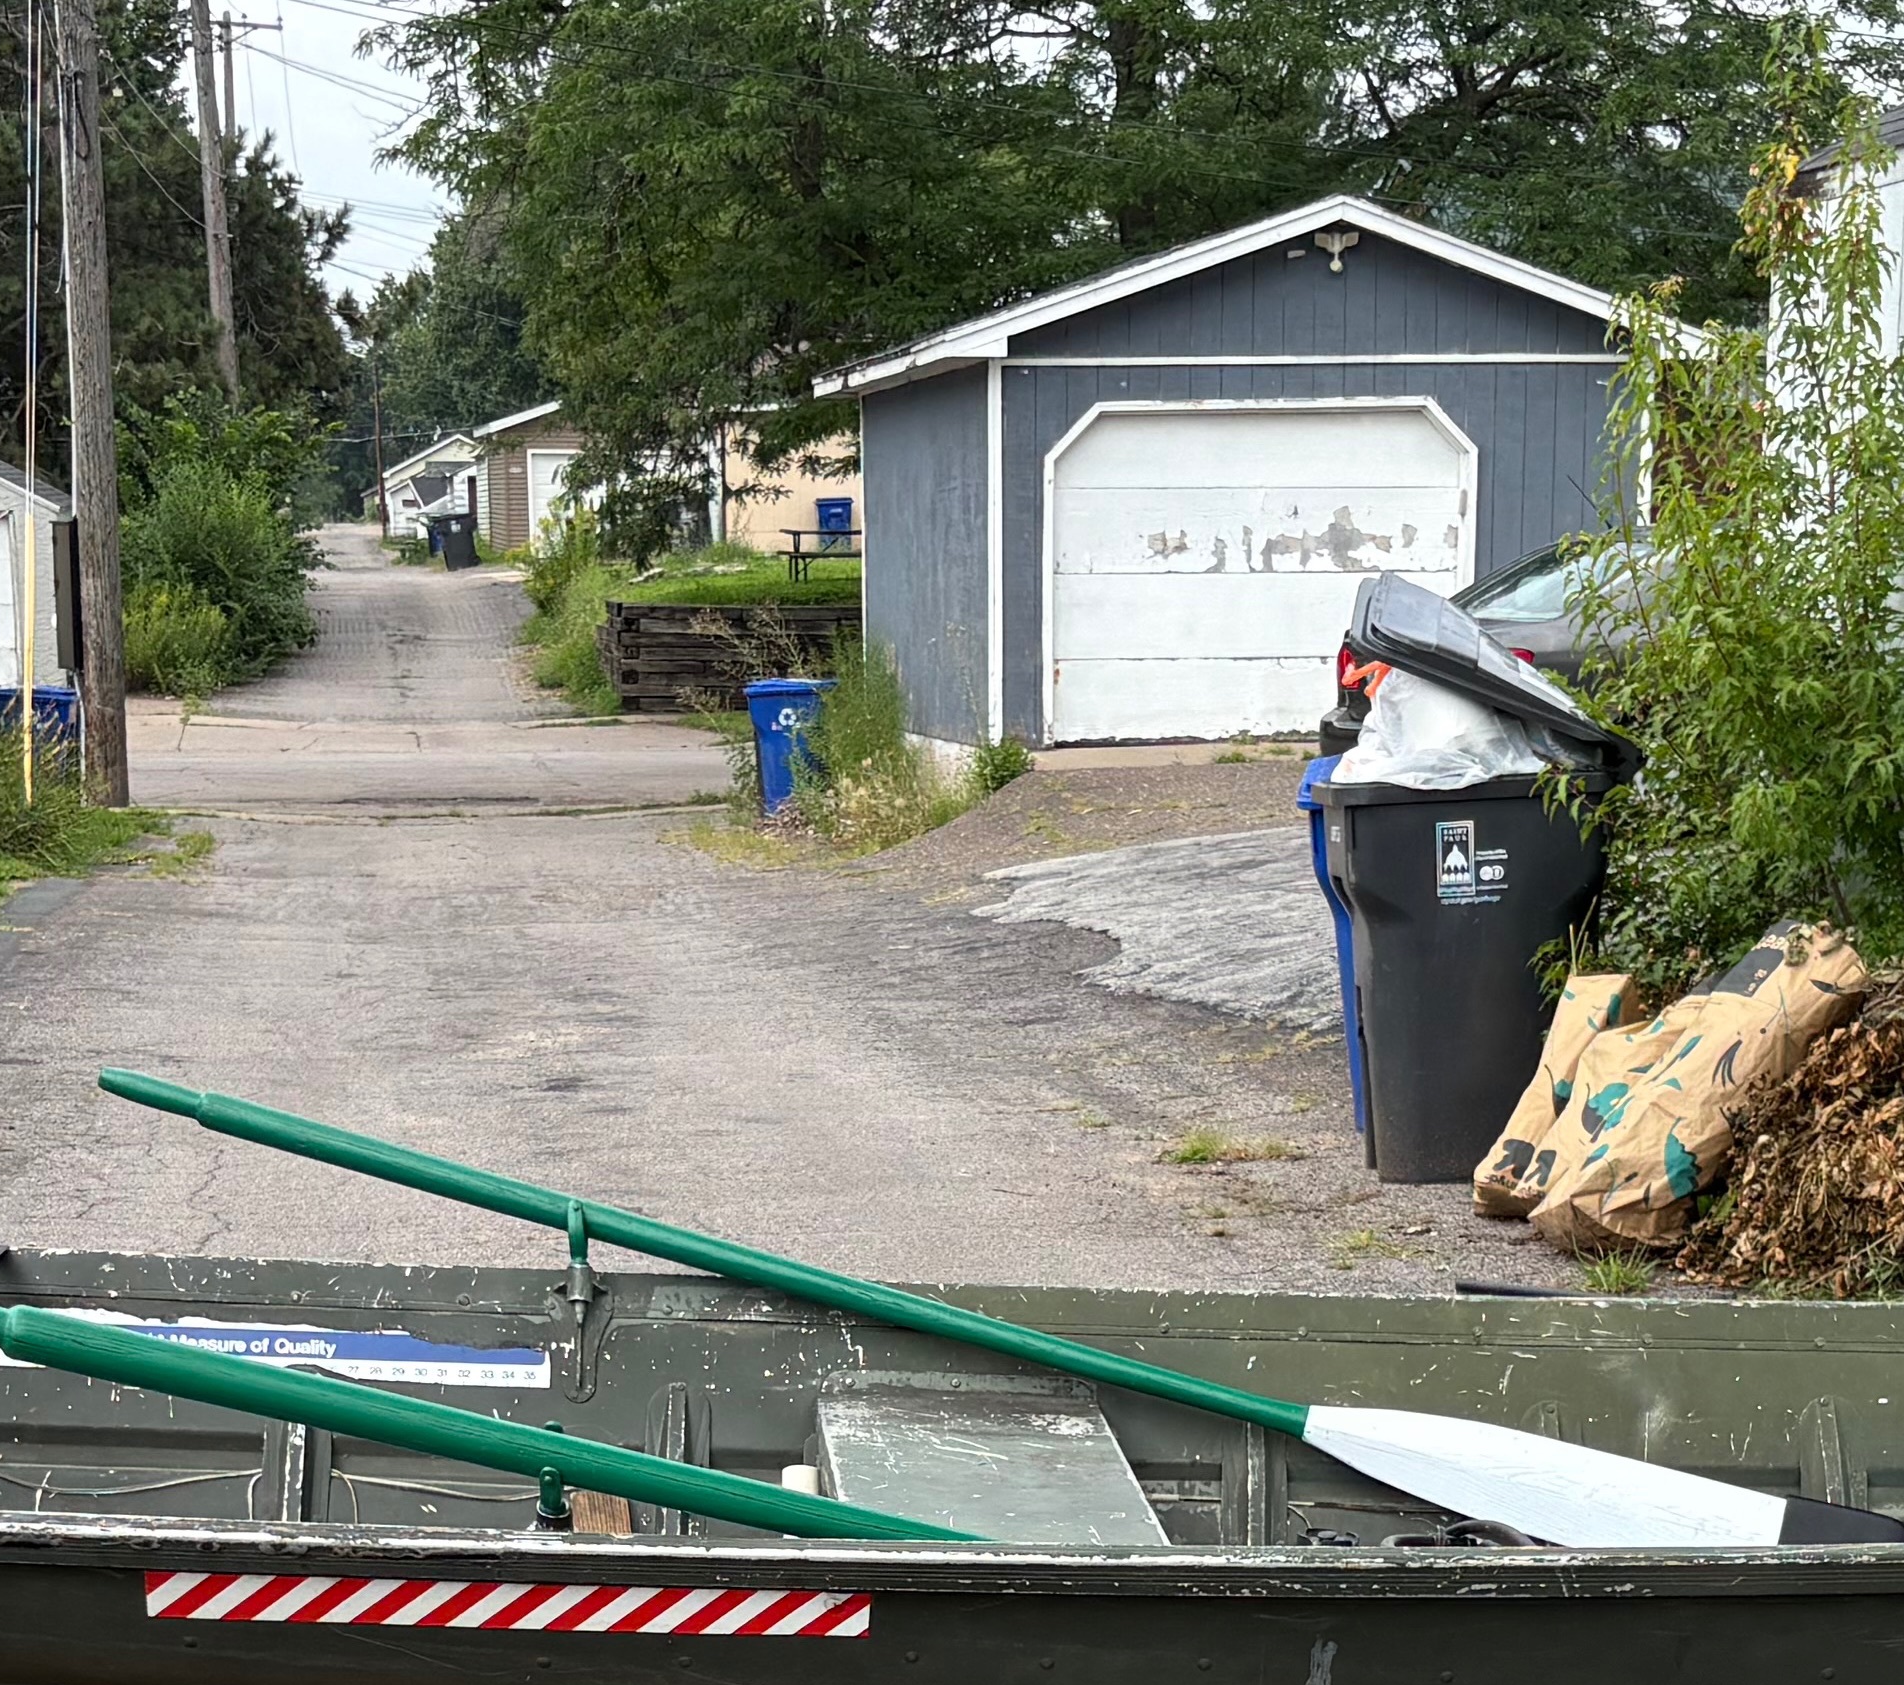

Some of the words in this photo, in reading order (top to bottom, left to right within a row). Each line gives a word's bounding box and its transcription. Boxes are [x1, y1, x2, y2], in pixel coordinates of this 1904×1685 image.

[249, 1338, 270, 1354] of
[274, 1337, 337, 1359] Quality
[347, 1366, 359, 1374] 27
[369, 1367, 382, 1375] 28
[392, 1367, 405, 1376] 29
[414, 1368, 428, 1377] 30
[436, 1368, 448, 1378] 31
[458, 1369, 471, 1378] 32
[480, 1370, 494, 1379] 33
[501, 1370, 515, 1379] 34
[523, 1371, 537, 1380] 35
